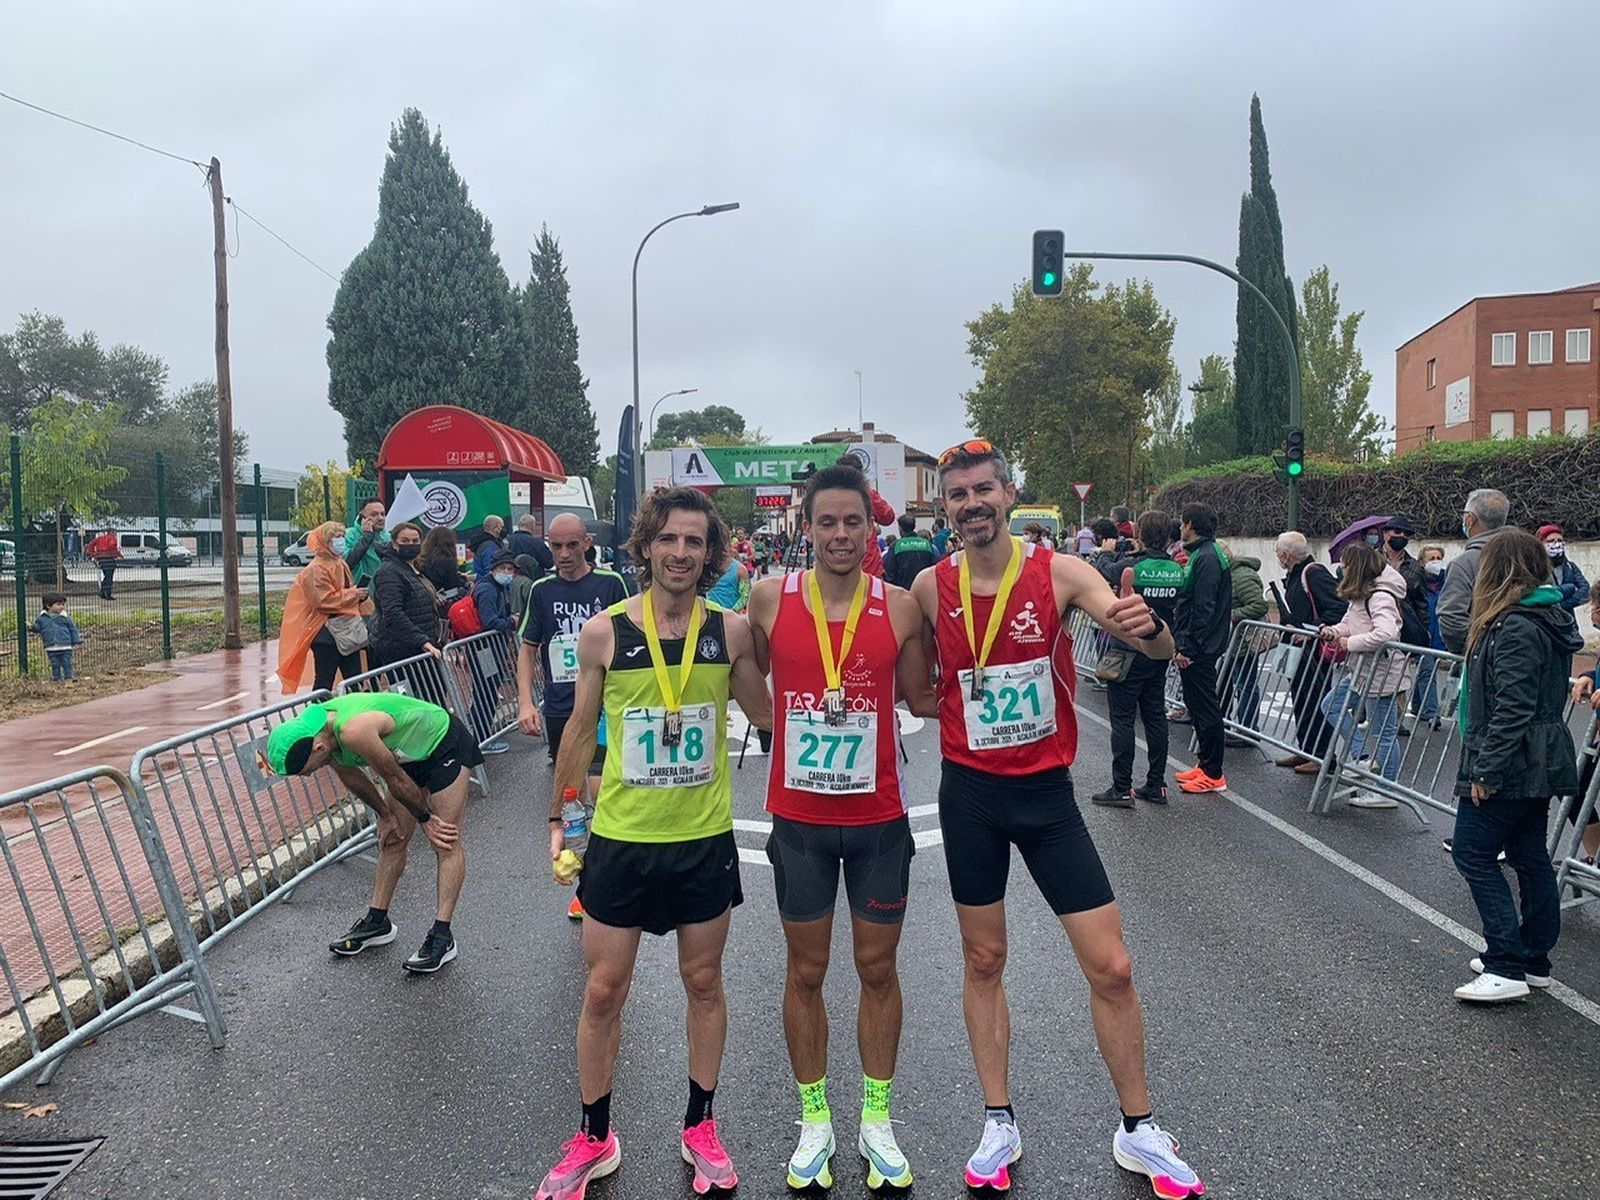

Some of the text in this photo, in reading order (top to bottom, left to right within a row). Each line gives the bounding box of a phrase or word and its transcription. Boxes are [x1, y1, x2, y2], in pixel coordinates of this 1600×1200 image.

[752, 448, 789, 456] Atletismo
[1143, 586, 1177, 598] RUBIO
[553, 601, 591, 617] RUN
[782, 690, 878, 712] TARACÓN
[978, 682, 1042, 726] 321
[992, 724, 1021, 736] CARRERA
[797, 732, 863, 770] 277
[649, 766, 678, 777] CARRERA
[808, 770, 836, 783] CARRERA
